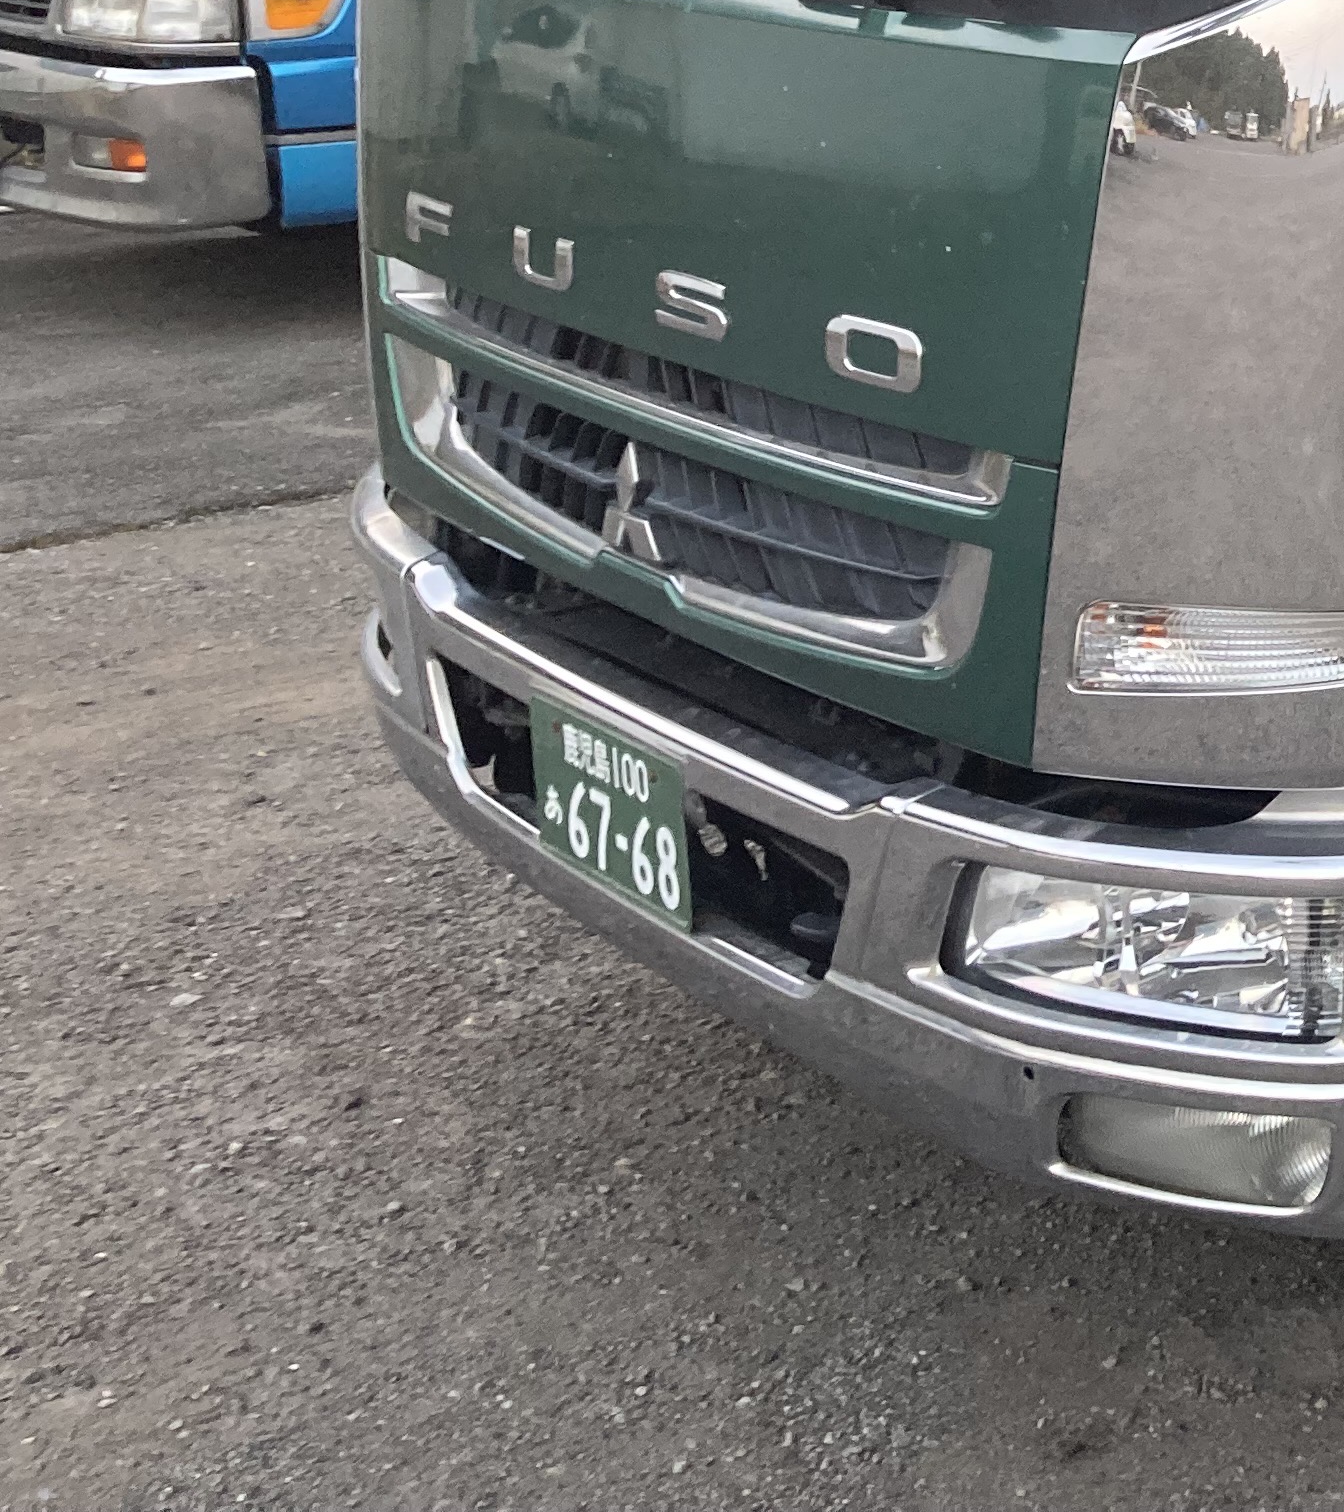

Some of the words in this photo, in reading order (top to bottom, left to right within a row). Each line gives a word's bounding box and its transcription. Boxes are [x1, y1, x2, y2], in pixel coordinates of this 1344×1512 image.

[406, 191, 924, 394] FUSO
[544, 784, 564, 826] あ
[567, 781, 681, 912] 67-68
